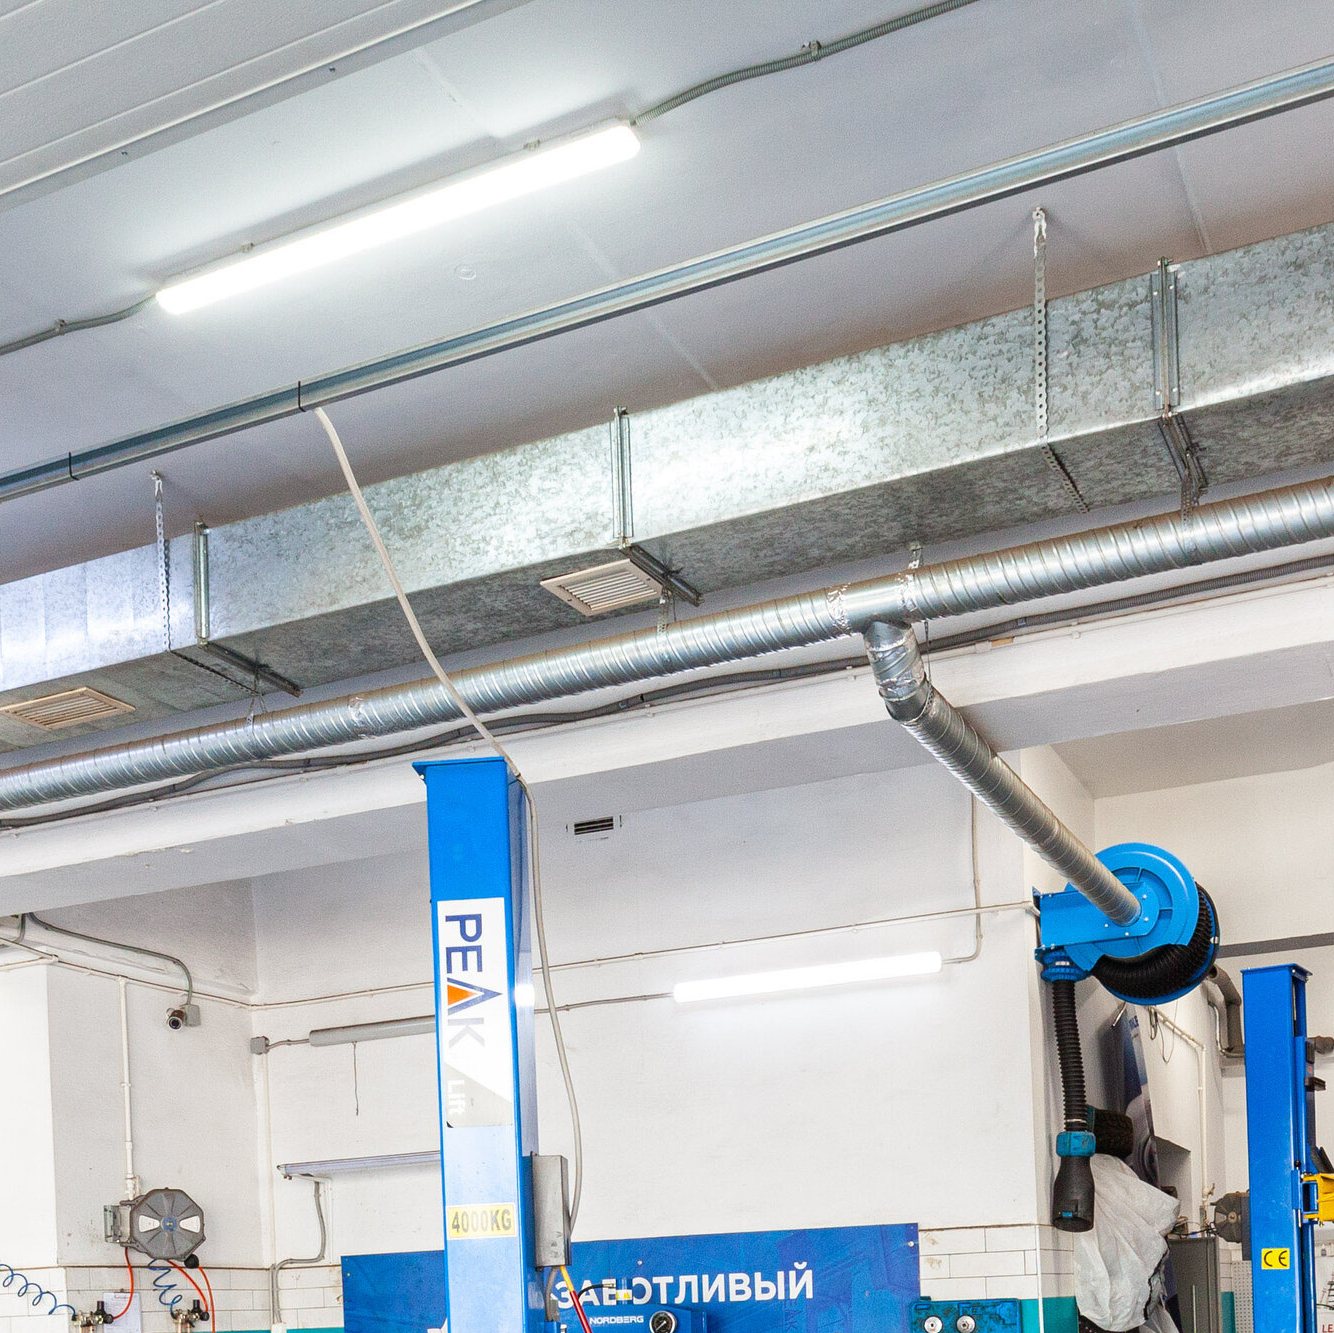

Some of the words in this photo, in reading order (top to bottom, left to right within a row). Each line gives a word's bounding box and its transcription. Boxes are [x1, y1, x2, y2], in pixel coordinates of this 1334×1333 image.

[445, 913, 503, 1048] PEAK
[447, 1079, 467, 1115] Lift
[451, 1209, 512, 1233] 4000KG
[589, 1315, 644, 1325] NORDBERG
